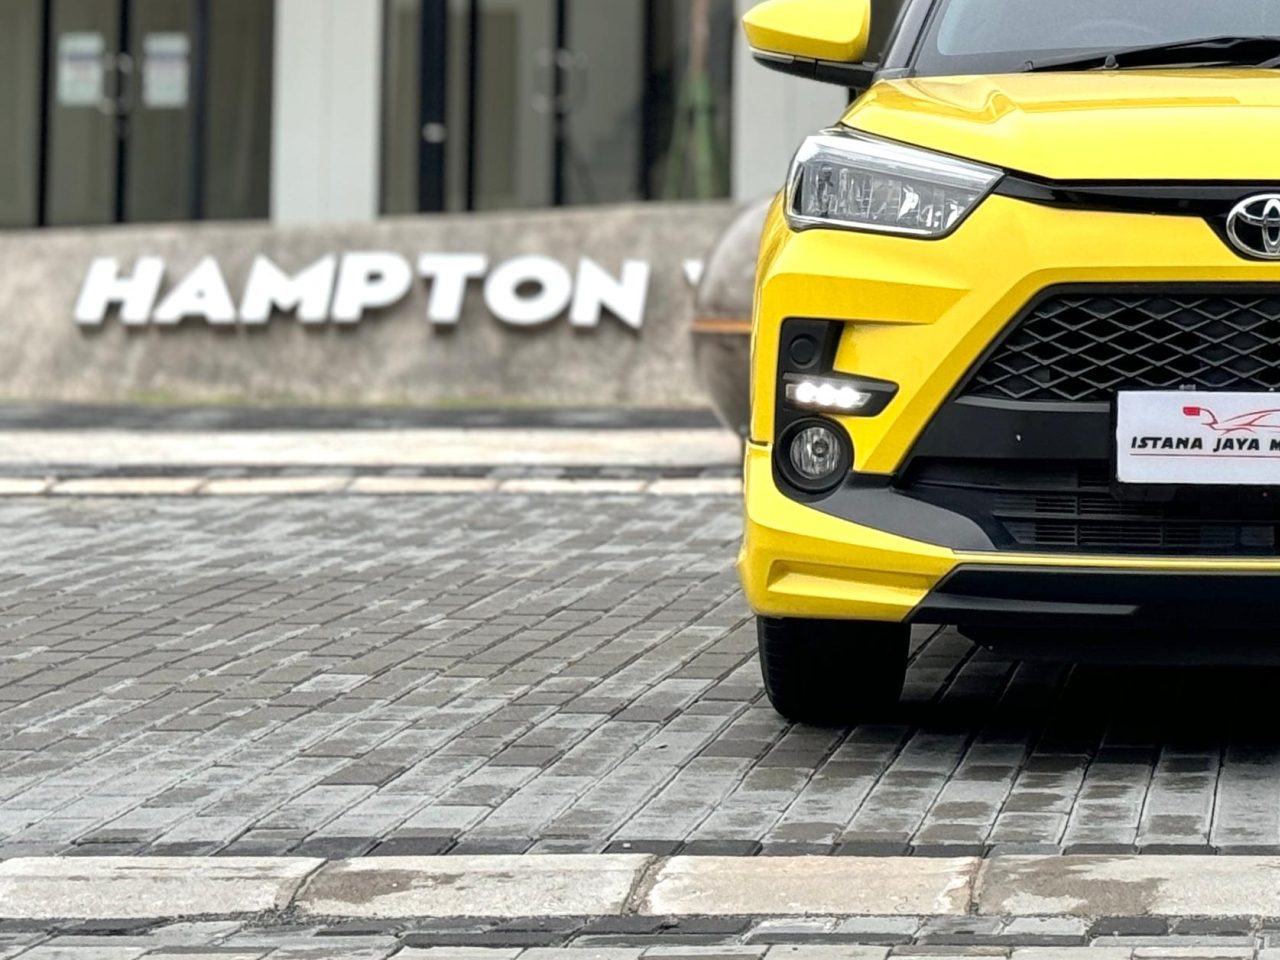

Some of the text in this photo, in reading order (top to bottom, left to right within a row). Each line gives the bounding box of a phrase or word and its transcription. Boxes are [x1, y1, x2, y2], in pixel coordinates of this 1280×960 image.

[75, 252, 650, 330] HAMPTON
[1131, 436, 1203, 450] ISTANA
[1213, 437, 1260, 452] JAYA
